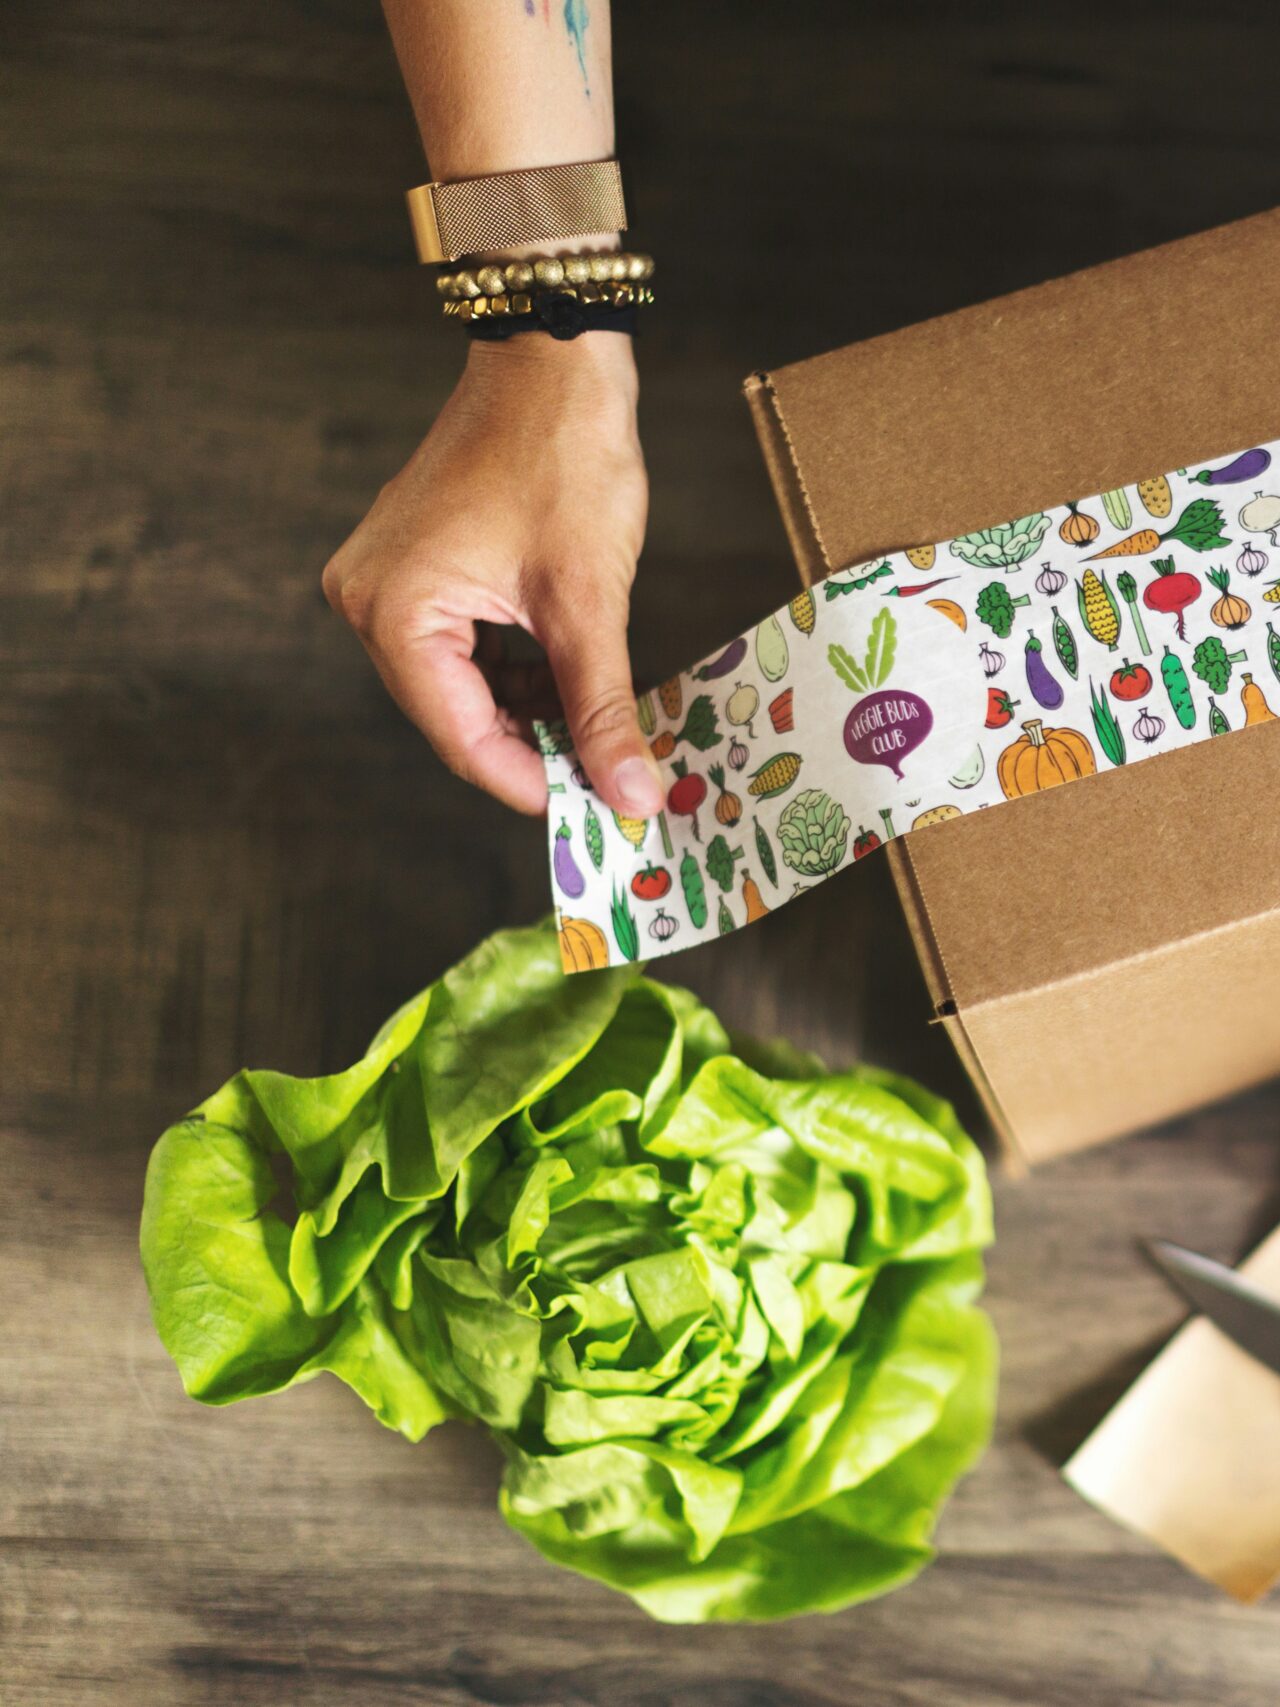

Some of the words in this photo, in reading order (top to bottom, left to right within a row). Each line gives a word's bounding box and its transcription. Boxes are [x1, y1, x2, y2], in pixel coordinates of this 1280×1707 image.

[851, 704, 887, 741] VEGGIE
[884, 700, 920, 724] BUDS
[872, 729, 907, 755] CLUB
